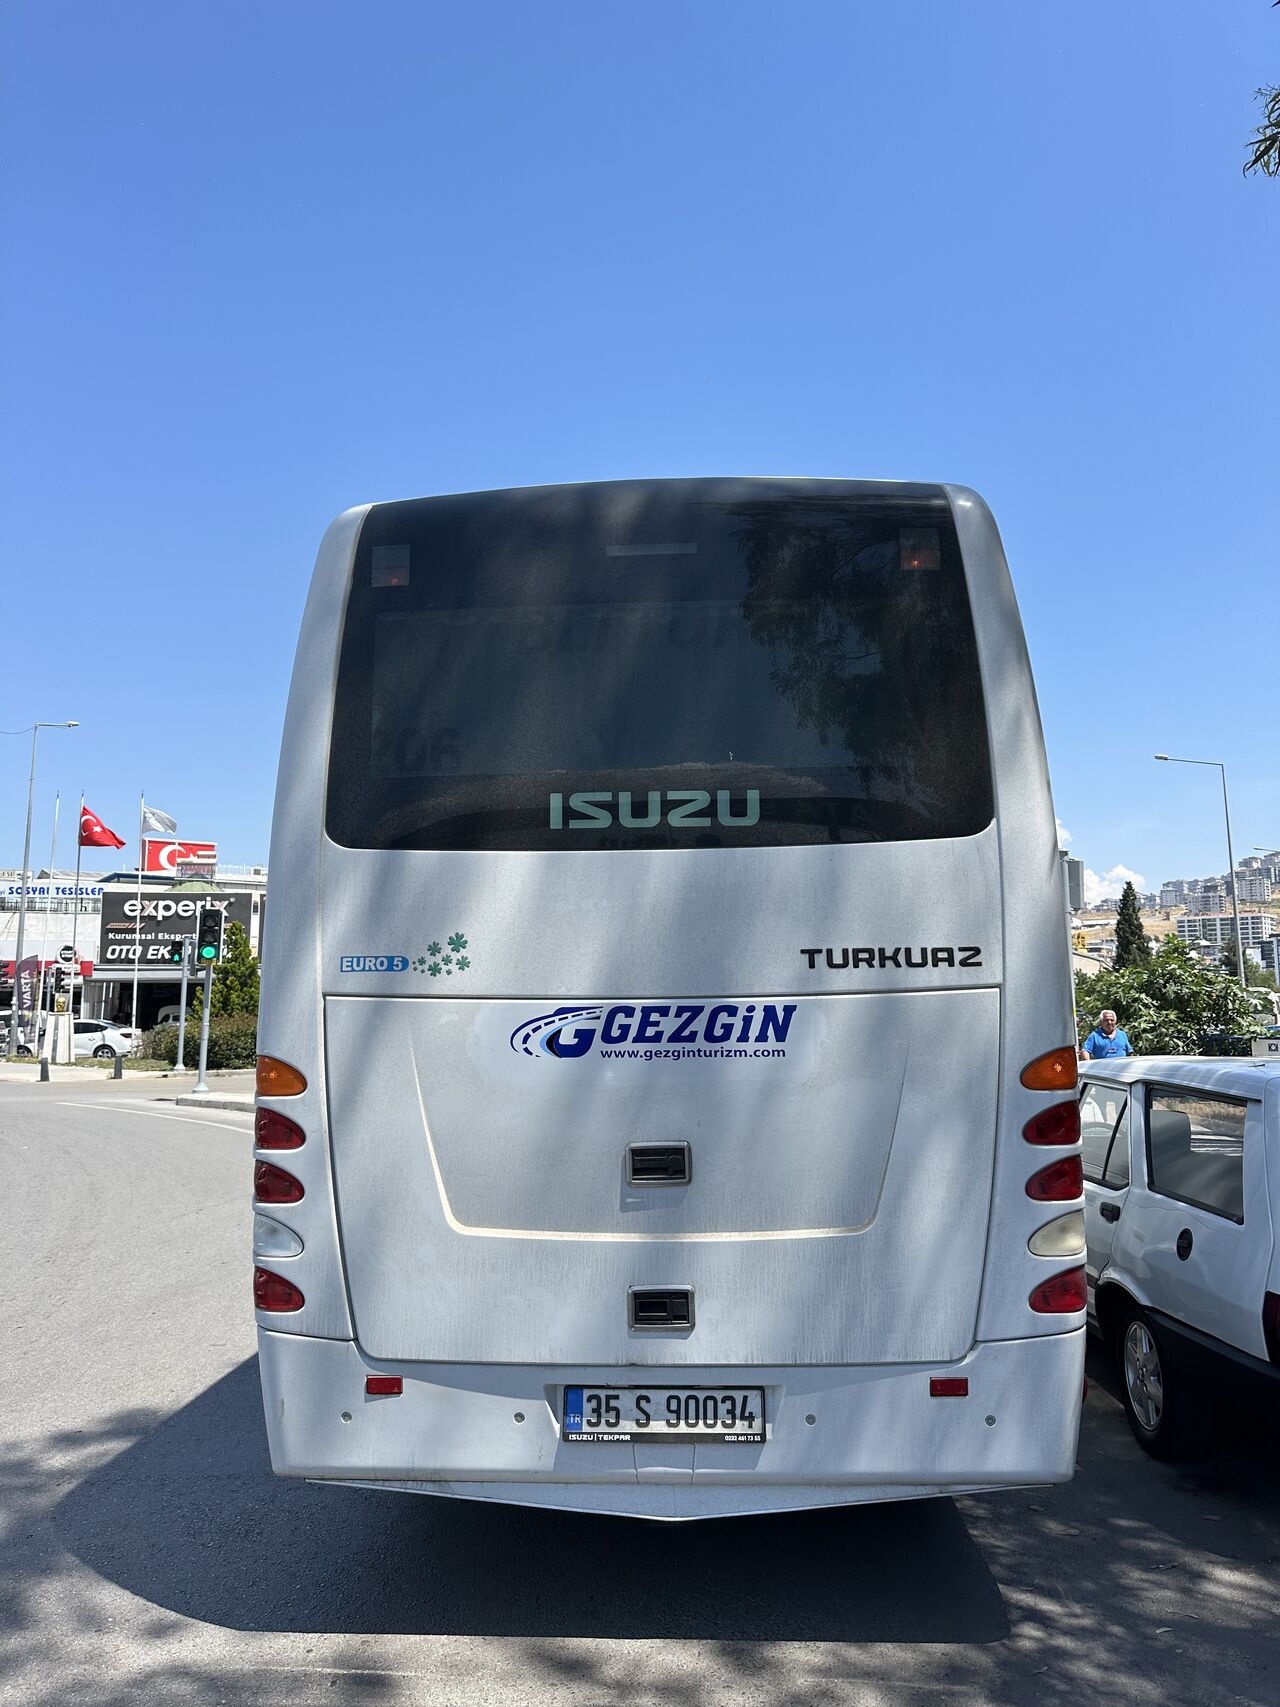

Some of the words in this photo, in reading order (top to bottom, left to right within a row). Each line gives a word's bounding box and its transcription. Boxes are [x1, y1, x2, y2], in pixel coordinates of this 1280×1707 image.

[550, 789, 760, 829] ISUZU
[108, 932, 155, 940] Kurumsal
[106, 945, 142, 960] OTO
[800, 946, 983, 969] TURKUAZ
[342, 957, 388, 971] EURO
[393, 957, 403, 971] 5
[20, 969, 32, 1008] VARTA
[600, 1047, 787, 1061] www.gezginturizm.com
[568, 1414, 582, 1424] TR
[586, 1394, 621, 1428] 35
[635, 1395, 651, 1428] S
[666, 1394, 756, 1429] 90034
